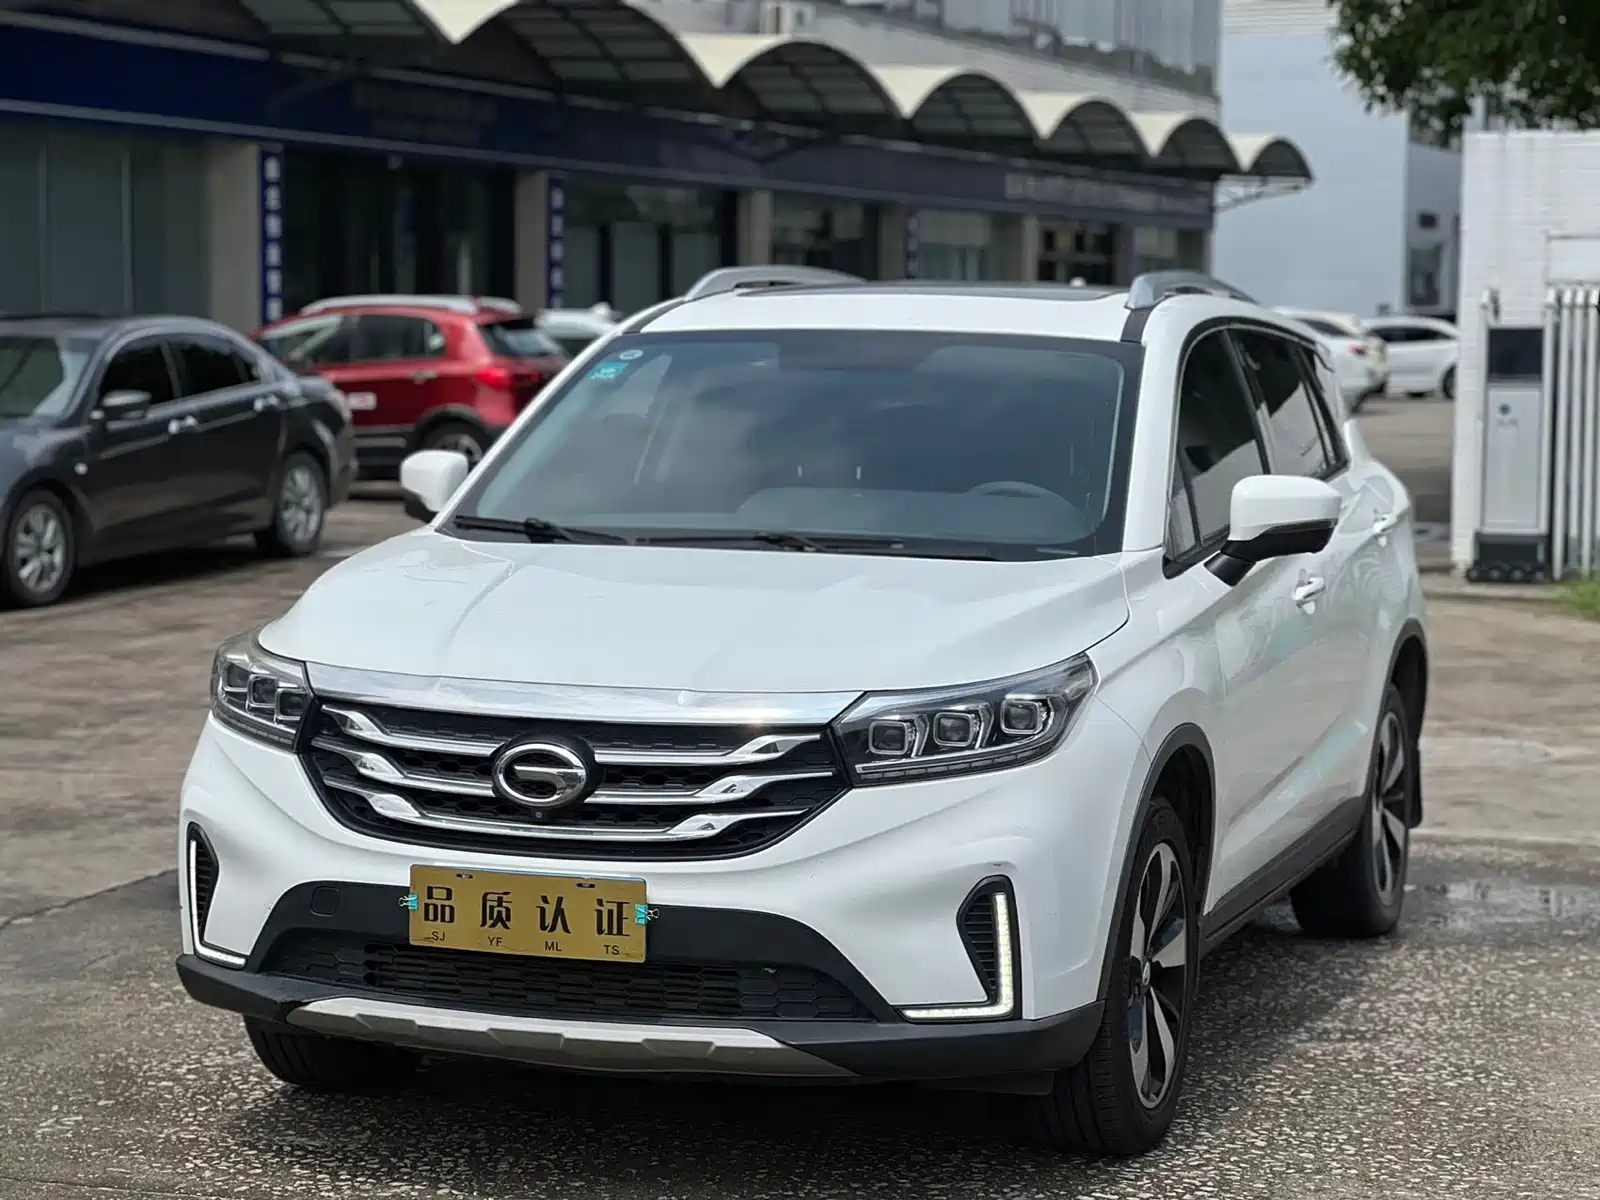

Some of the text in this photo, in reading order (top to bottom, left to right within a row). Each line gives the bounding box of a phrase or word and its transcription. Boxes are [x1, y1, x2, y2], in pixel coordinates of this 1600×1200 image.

[423, 885, 631, 937] 品质认证
[431, 930, 620, 956] SJ YF ML TS
